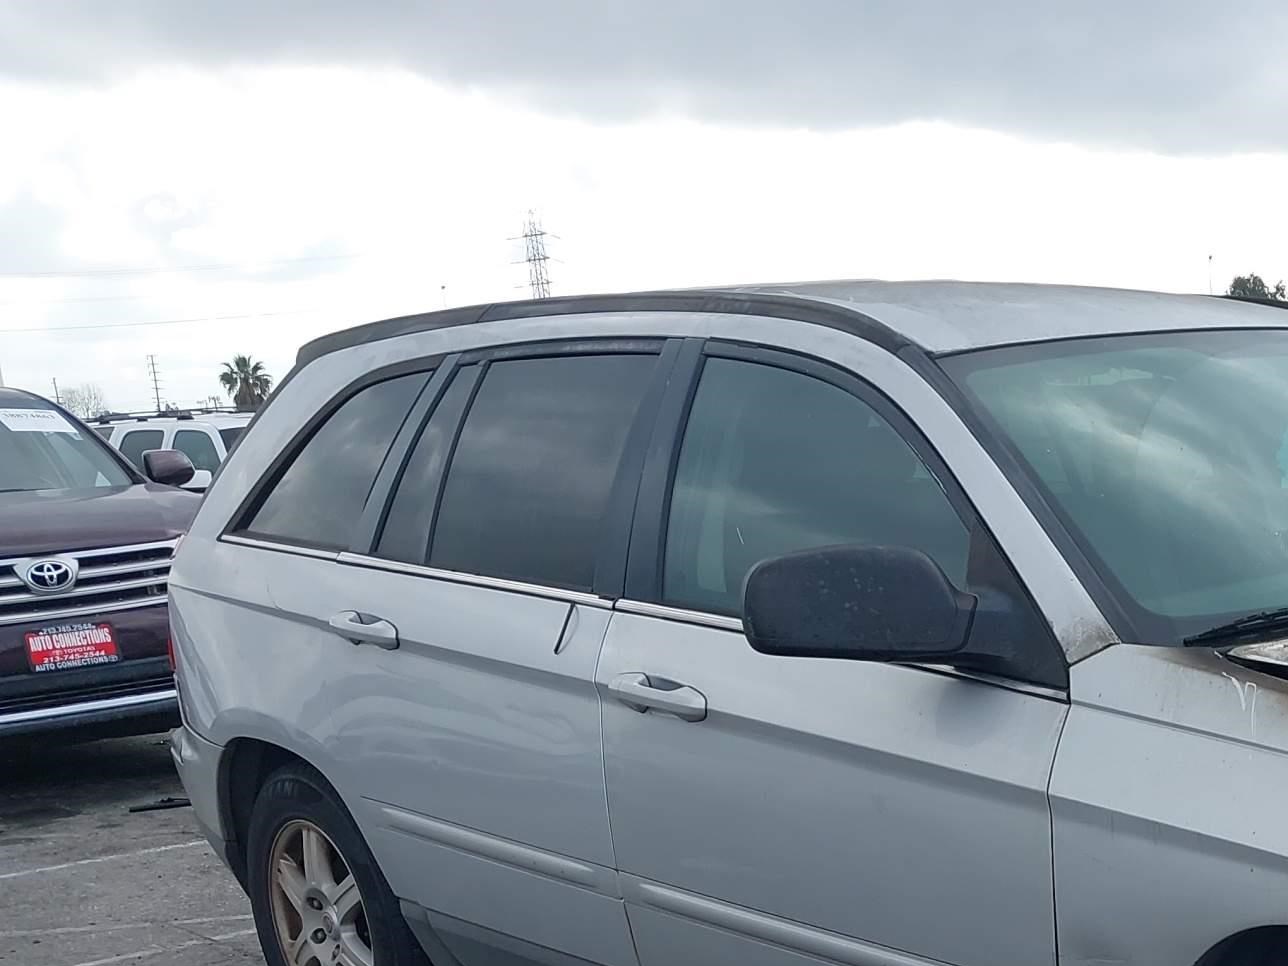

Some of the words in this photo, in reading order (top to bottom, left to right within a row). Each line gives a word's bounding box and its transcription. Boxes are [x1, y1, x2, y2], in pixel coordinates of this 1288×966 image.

[29, 636, 53, 652] AUTO
[52, 628, 111, 649] CONNECTIONS
[35, 663, 56, 672] AUTO
[56, 656, 109, 668] CONNECTIONS
[43, 650, 105, 663] 213-745-2544
